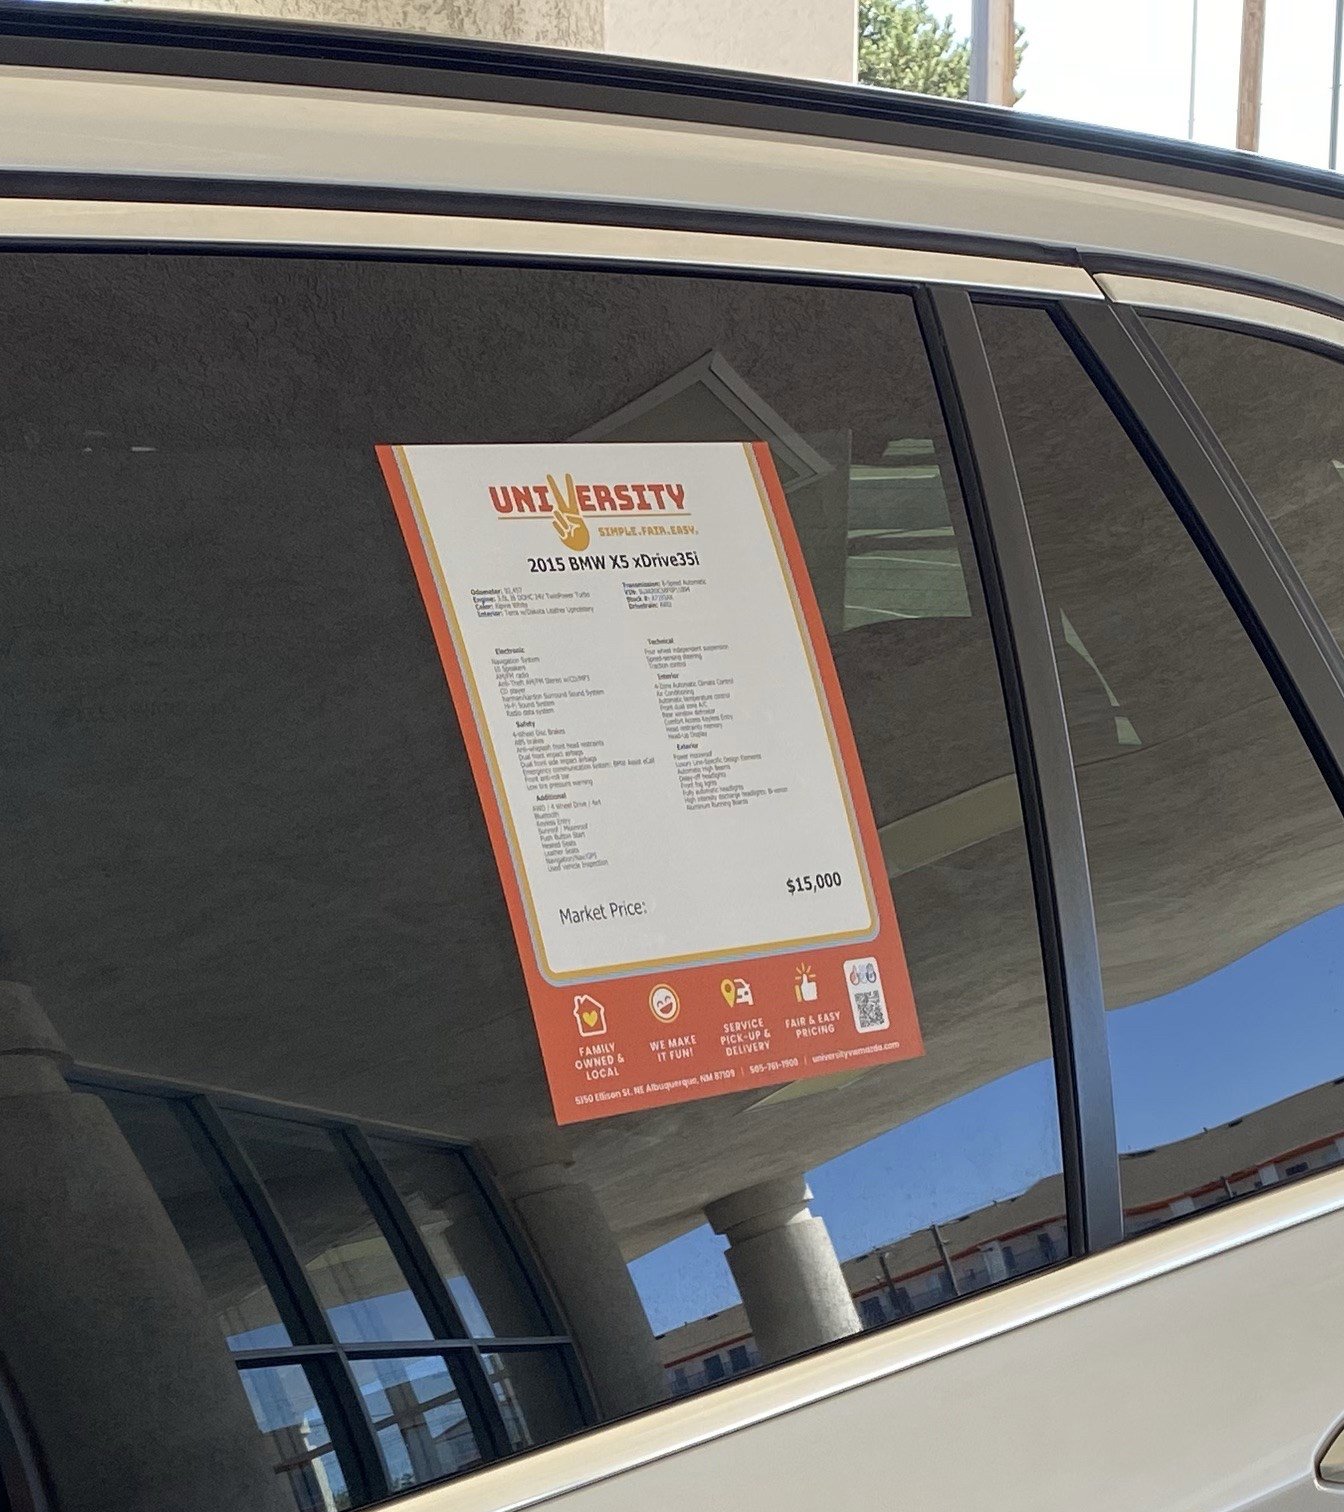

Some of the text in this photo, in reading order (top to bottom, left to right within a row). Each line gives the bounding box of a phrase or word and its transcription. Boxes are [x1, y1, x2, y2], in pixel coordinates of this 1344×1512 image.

[487, 482, 688, 513] UNIVERSITY
[526, 551, 700, 573] 2015 BMW X5 xDrive35i
[647, 637, 674, 645] Technical
[515, 720, 535, 728] Safety
[676, 742, 699, 750] Exterior
[535, 792, 567, 801] Additional
[784, 871, 843, 896] $15,000
[557, 897, 648, 925] Market Price:
[723, 1017, 764, 1033] SERVICE
[784, 1010, 842, 1029] FAIR & EASY
[719, 1028, 771, 1046] PICK-UP &
[795, 1023, 835, 1039] PRICING
[578, 1041, 616, 1058] FAMILY
[649, 1034, 697, 1052] WE MAKE
[725, 1039, 771, 1056] DELIVERY
[573, 1052, 625, 1071] OWNED &
[656, 1047, 694, 1062] IT FUN!
[585, 1065, 620, 1081] LOCAL
[748, 1057, 799, 1074] 505-761-1900
[574, 1093, 595, 1105] 5150
[698, 1072, 714, 1083] NM
[713, 1068, 736, 1081] 87109
